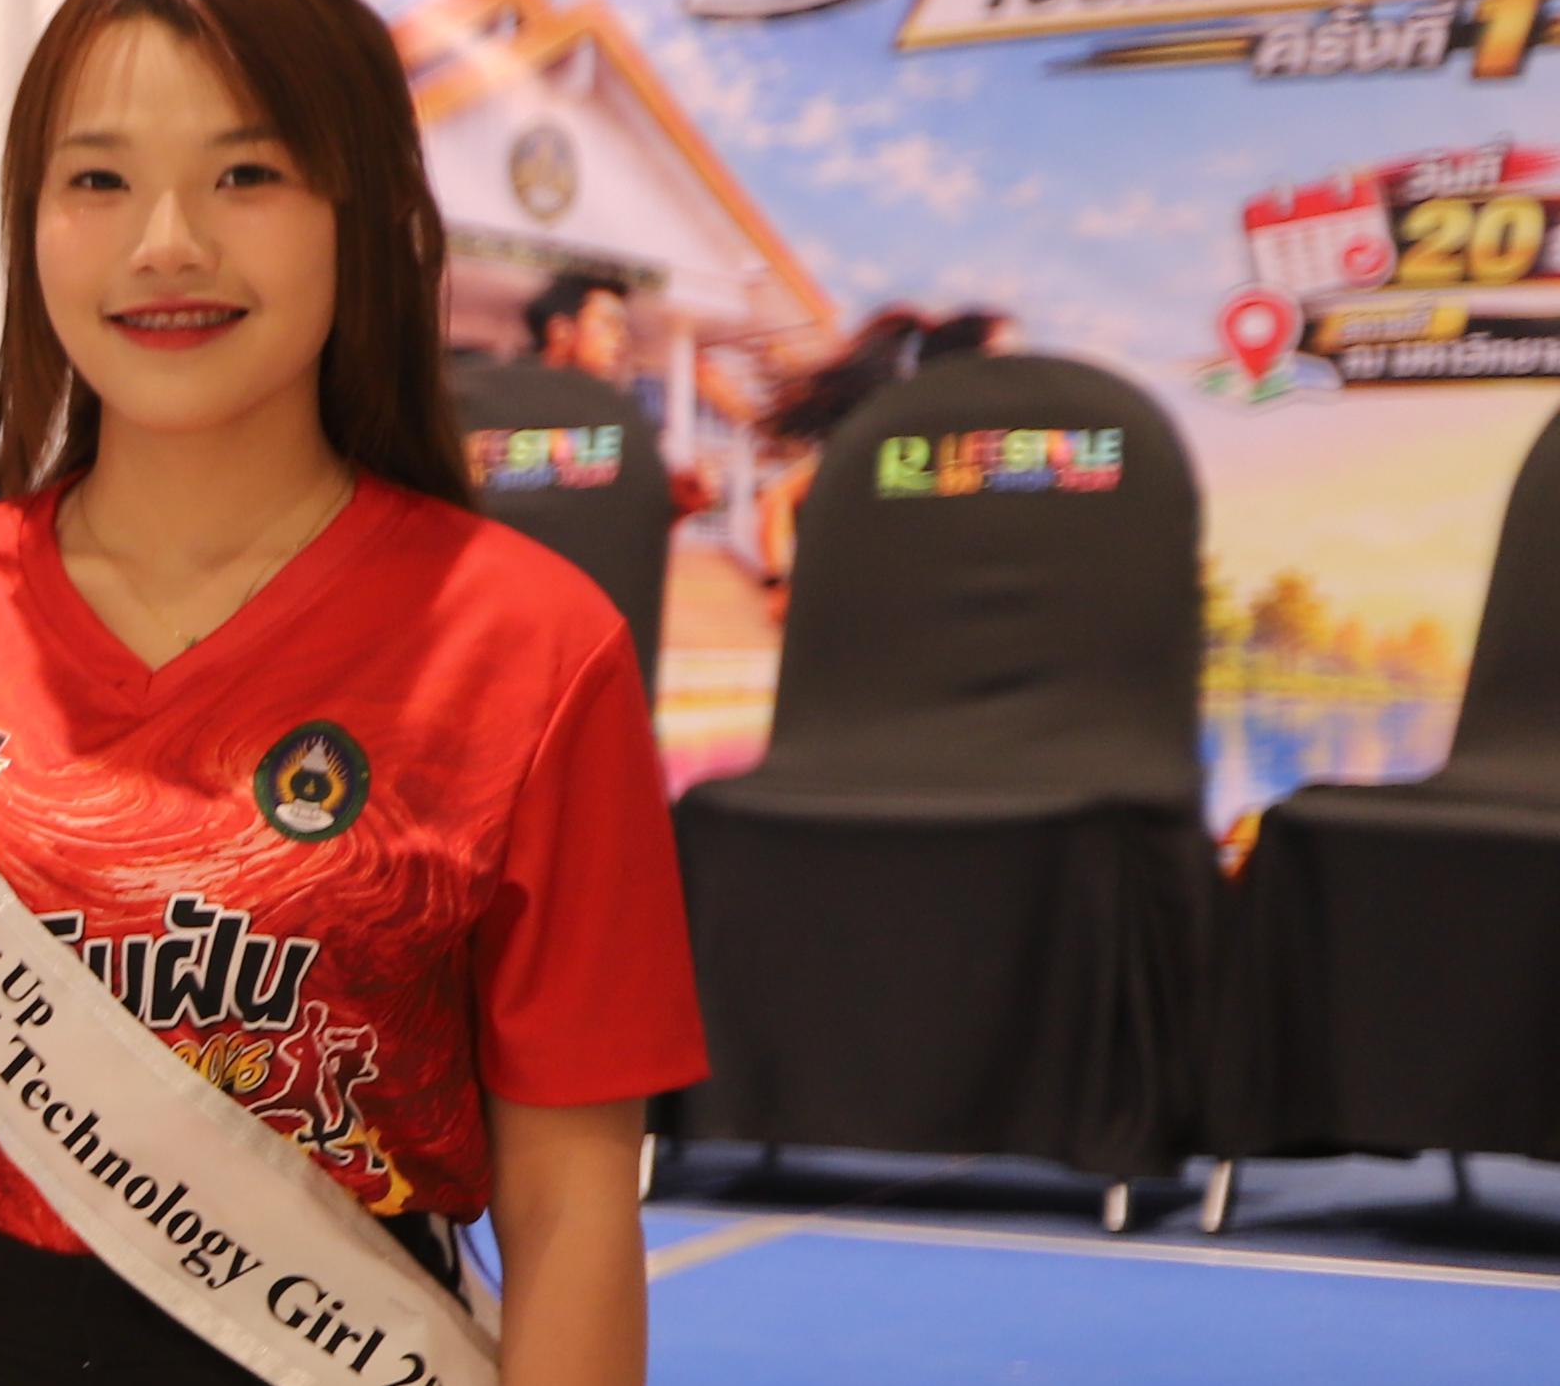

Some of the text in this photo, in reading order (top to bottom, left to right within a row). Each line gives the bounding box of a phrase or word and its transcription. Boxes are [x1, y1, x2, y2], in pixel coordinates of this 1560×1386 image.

[1398, 195, 1546, 285] 20
[1, 962, 54, 1029] Up
[265, 1271, 388, 1375] Girl
